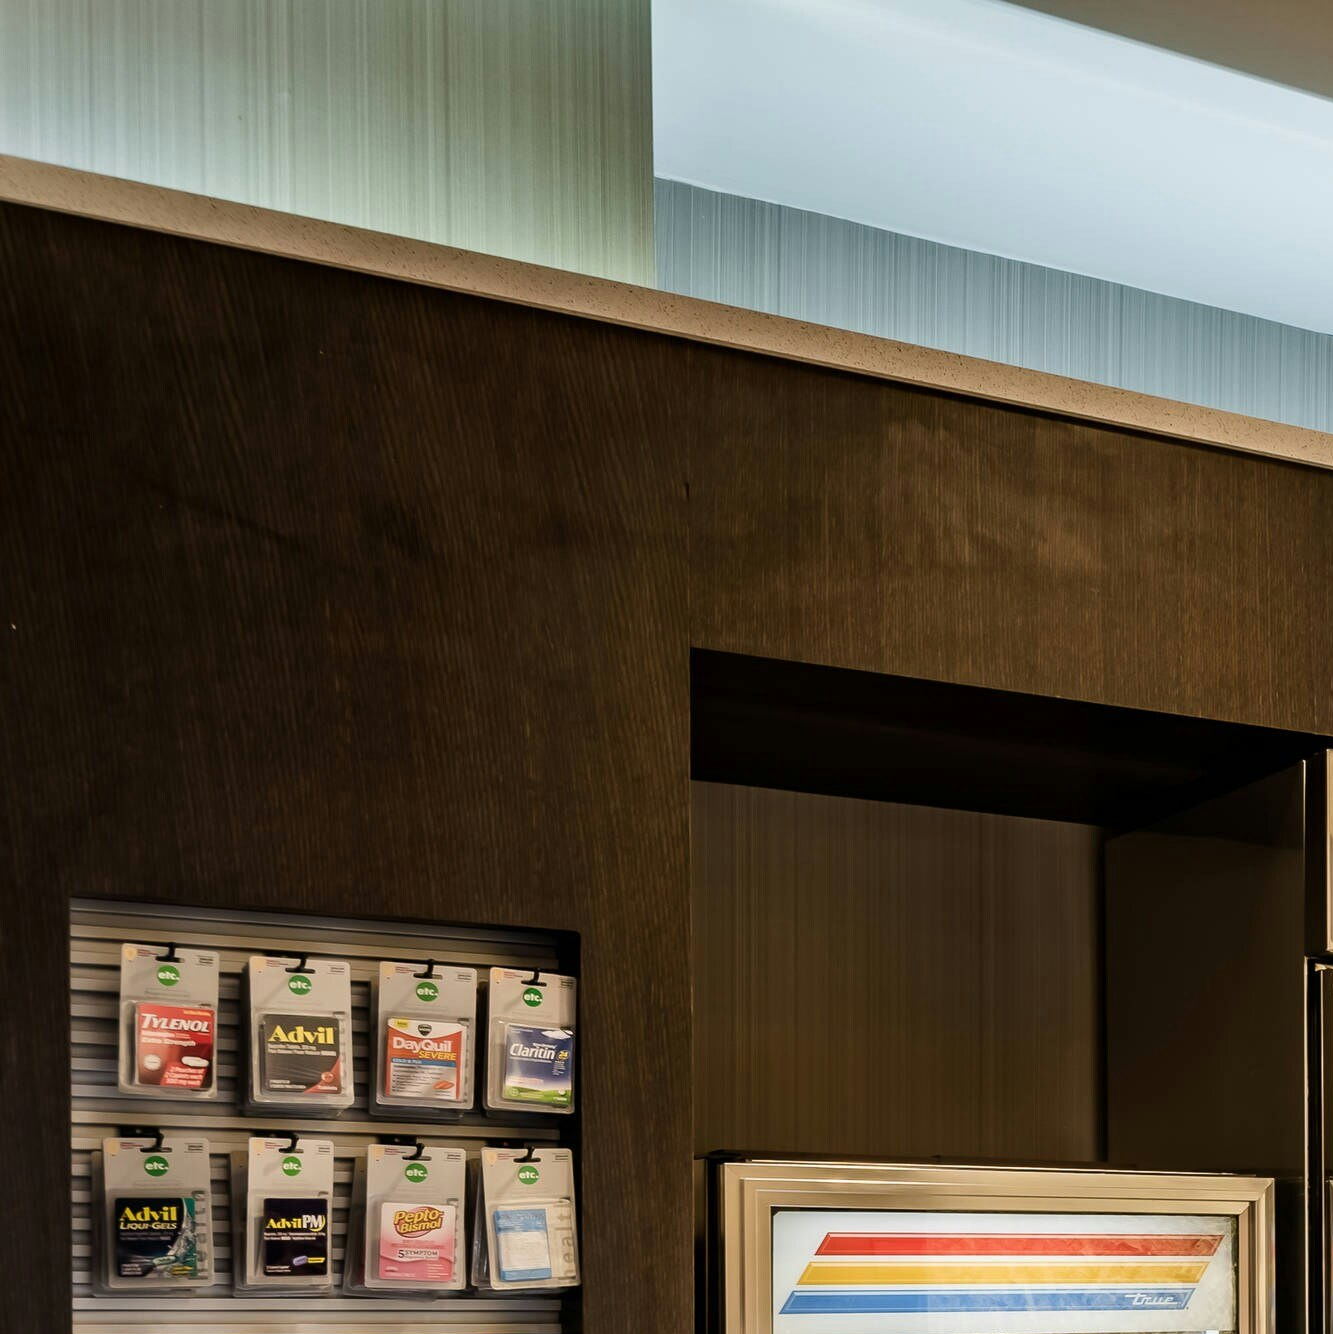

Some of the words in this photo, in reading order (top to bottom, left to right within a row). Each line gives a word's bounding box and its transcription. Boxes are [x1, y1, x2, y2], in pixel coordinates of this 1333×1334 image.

[141, 1013, 210, 1033] TYLENOL
[268, 1025, 334, 1045] Advil
[392, 1036, 453, 1054] DayQuil
[510, 1043, 556, 1060] Claritin
[418, 1050, 457, 1061] SEVERE
[119, 1206, 178, 1222] Advil
[119, 1221, 177, 1231] LIQUI-GELS
[399, 1217, 442, 1235] Bismol
